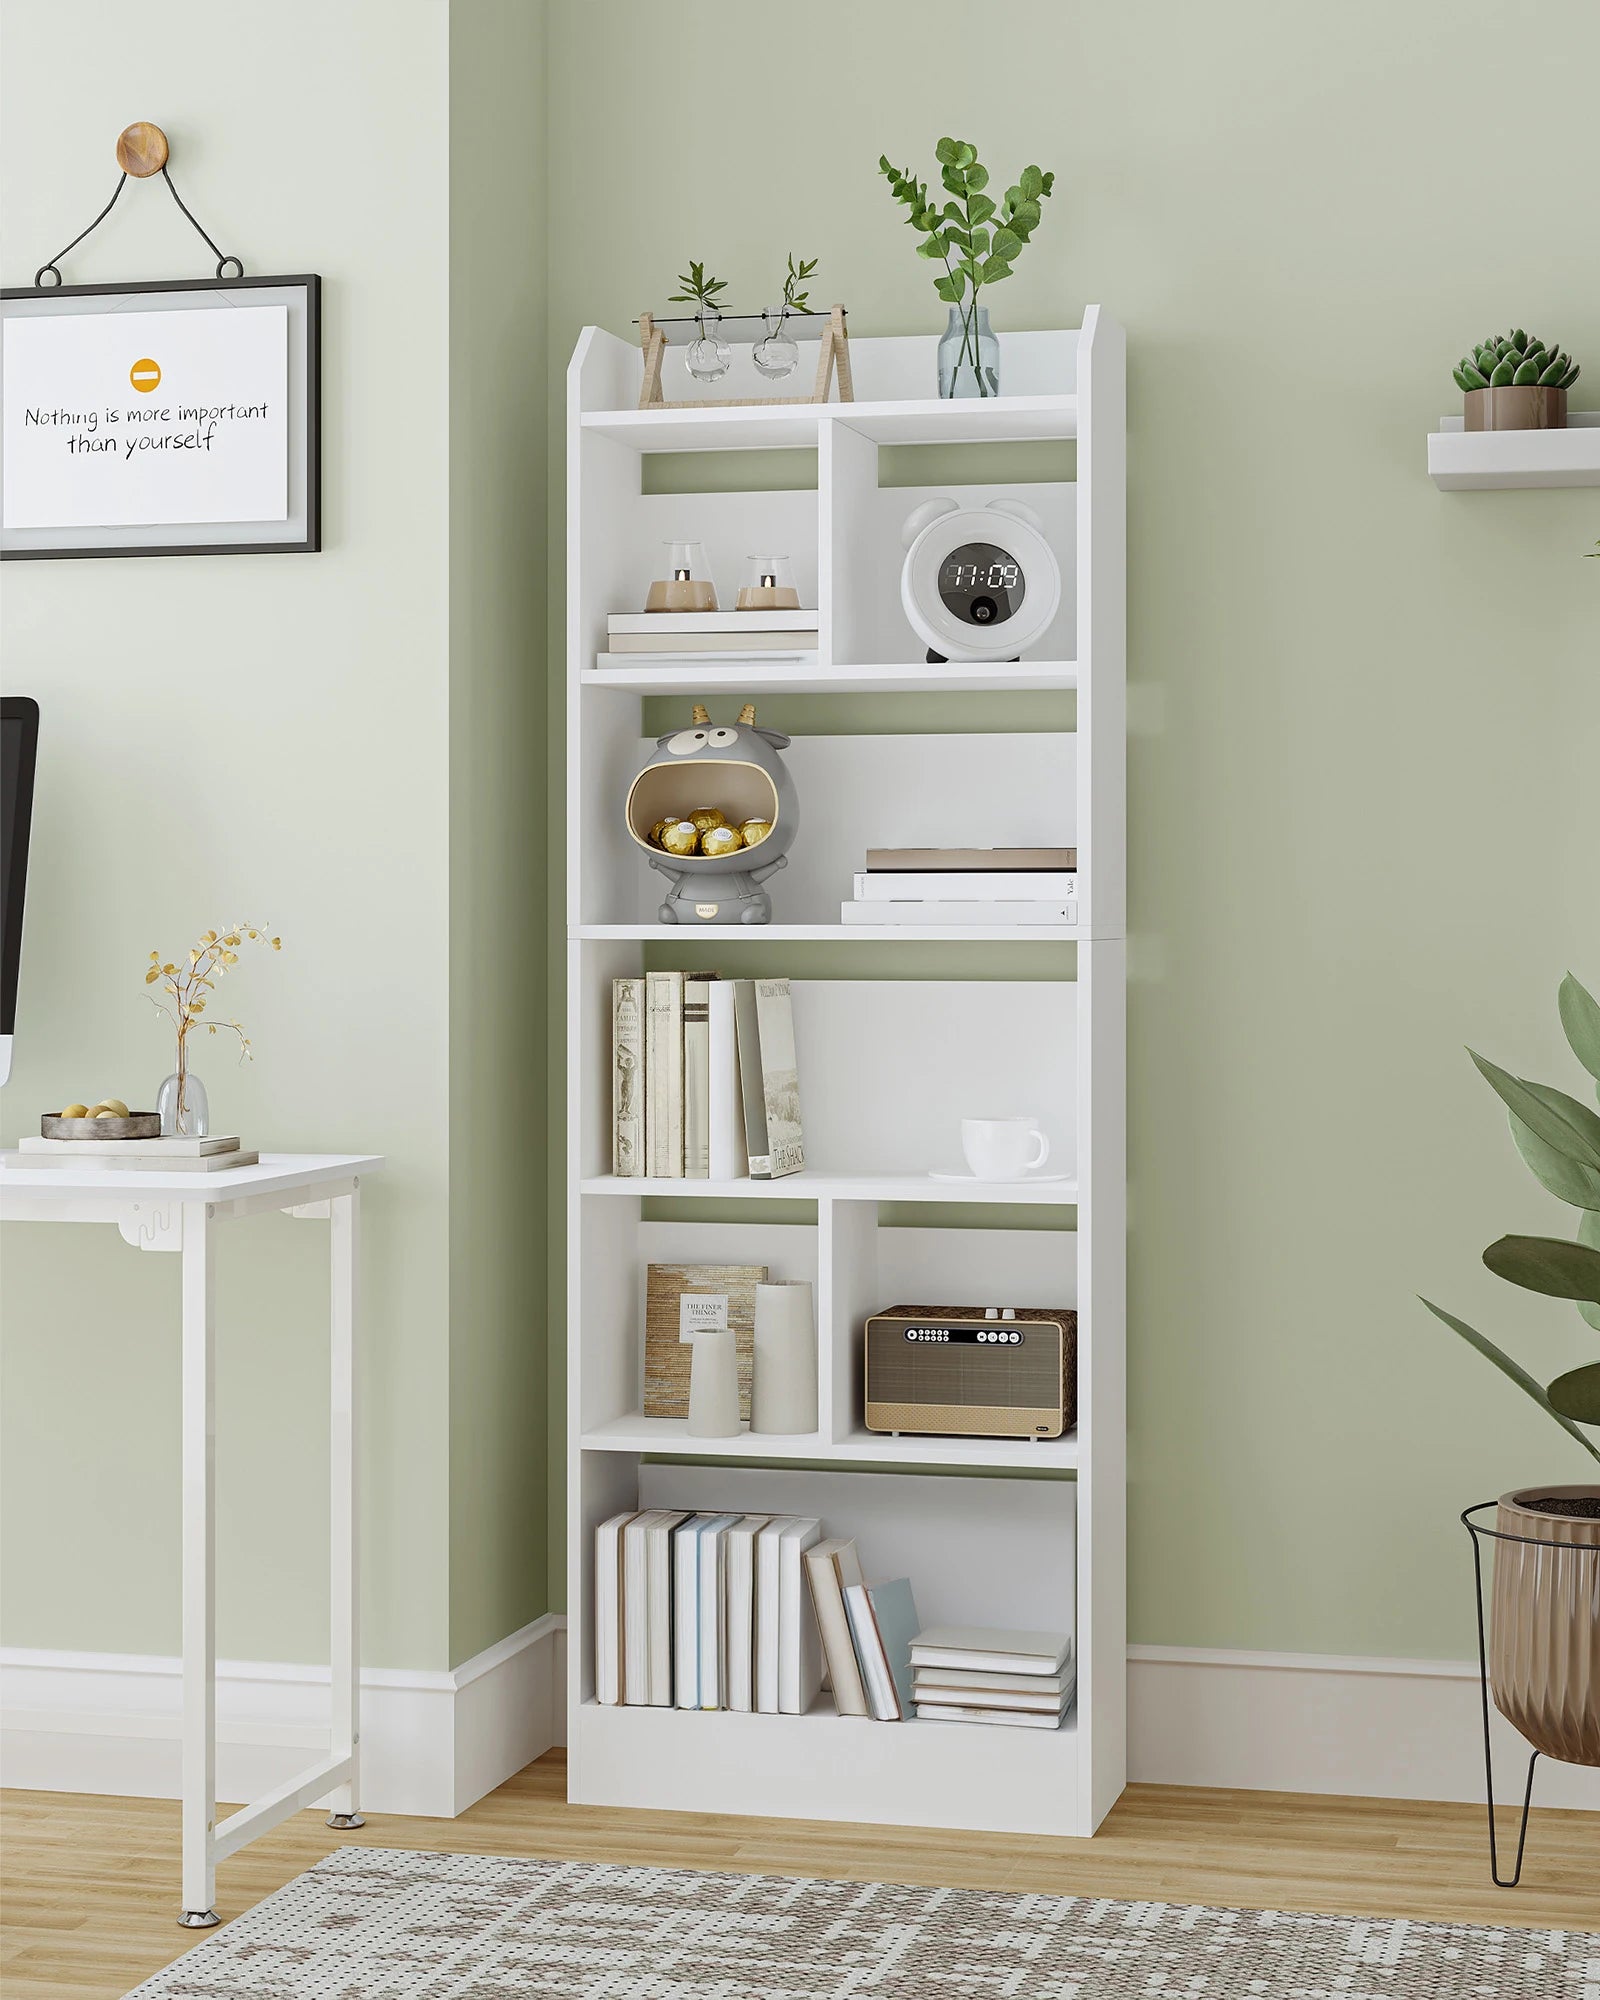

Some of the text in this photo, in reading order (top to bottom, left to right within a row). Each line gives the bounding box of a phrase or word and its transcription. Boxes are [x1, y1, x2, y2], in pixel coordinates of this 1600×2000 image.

[25, 402, 268, 432] Nothing is more important
[67, 421, 216, 460] than yourself
[955, 564, 1019, 588] 11:09
